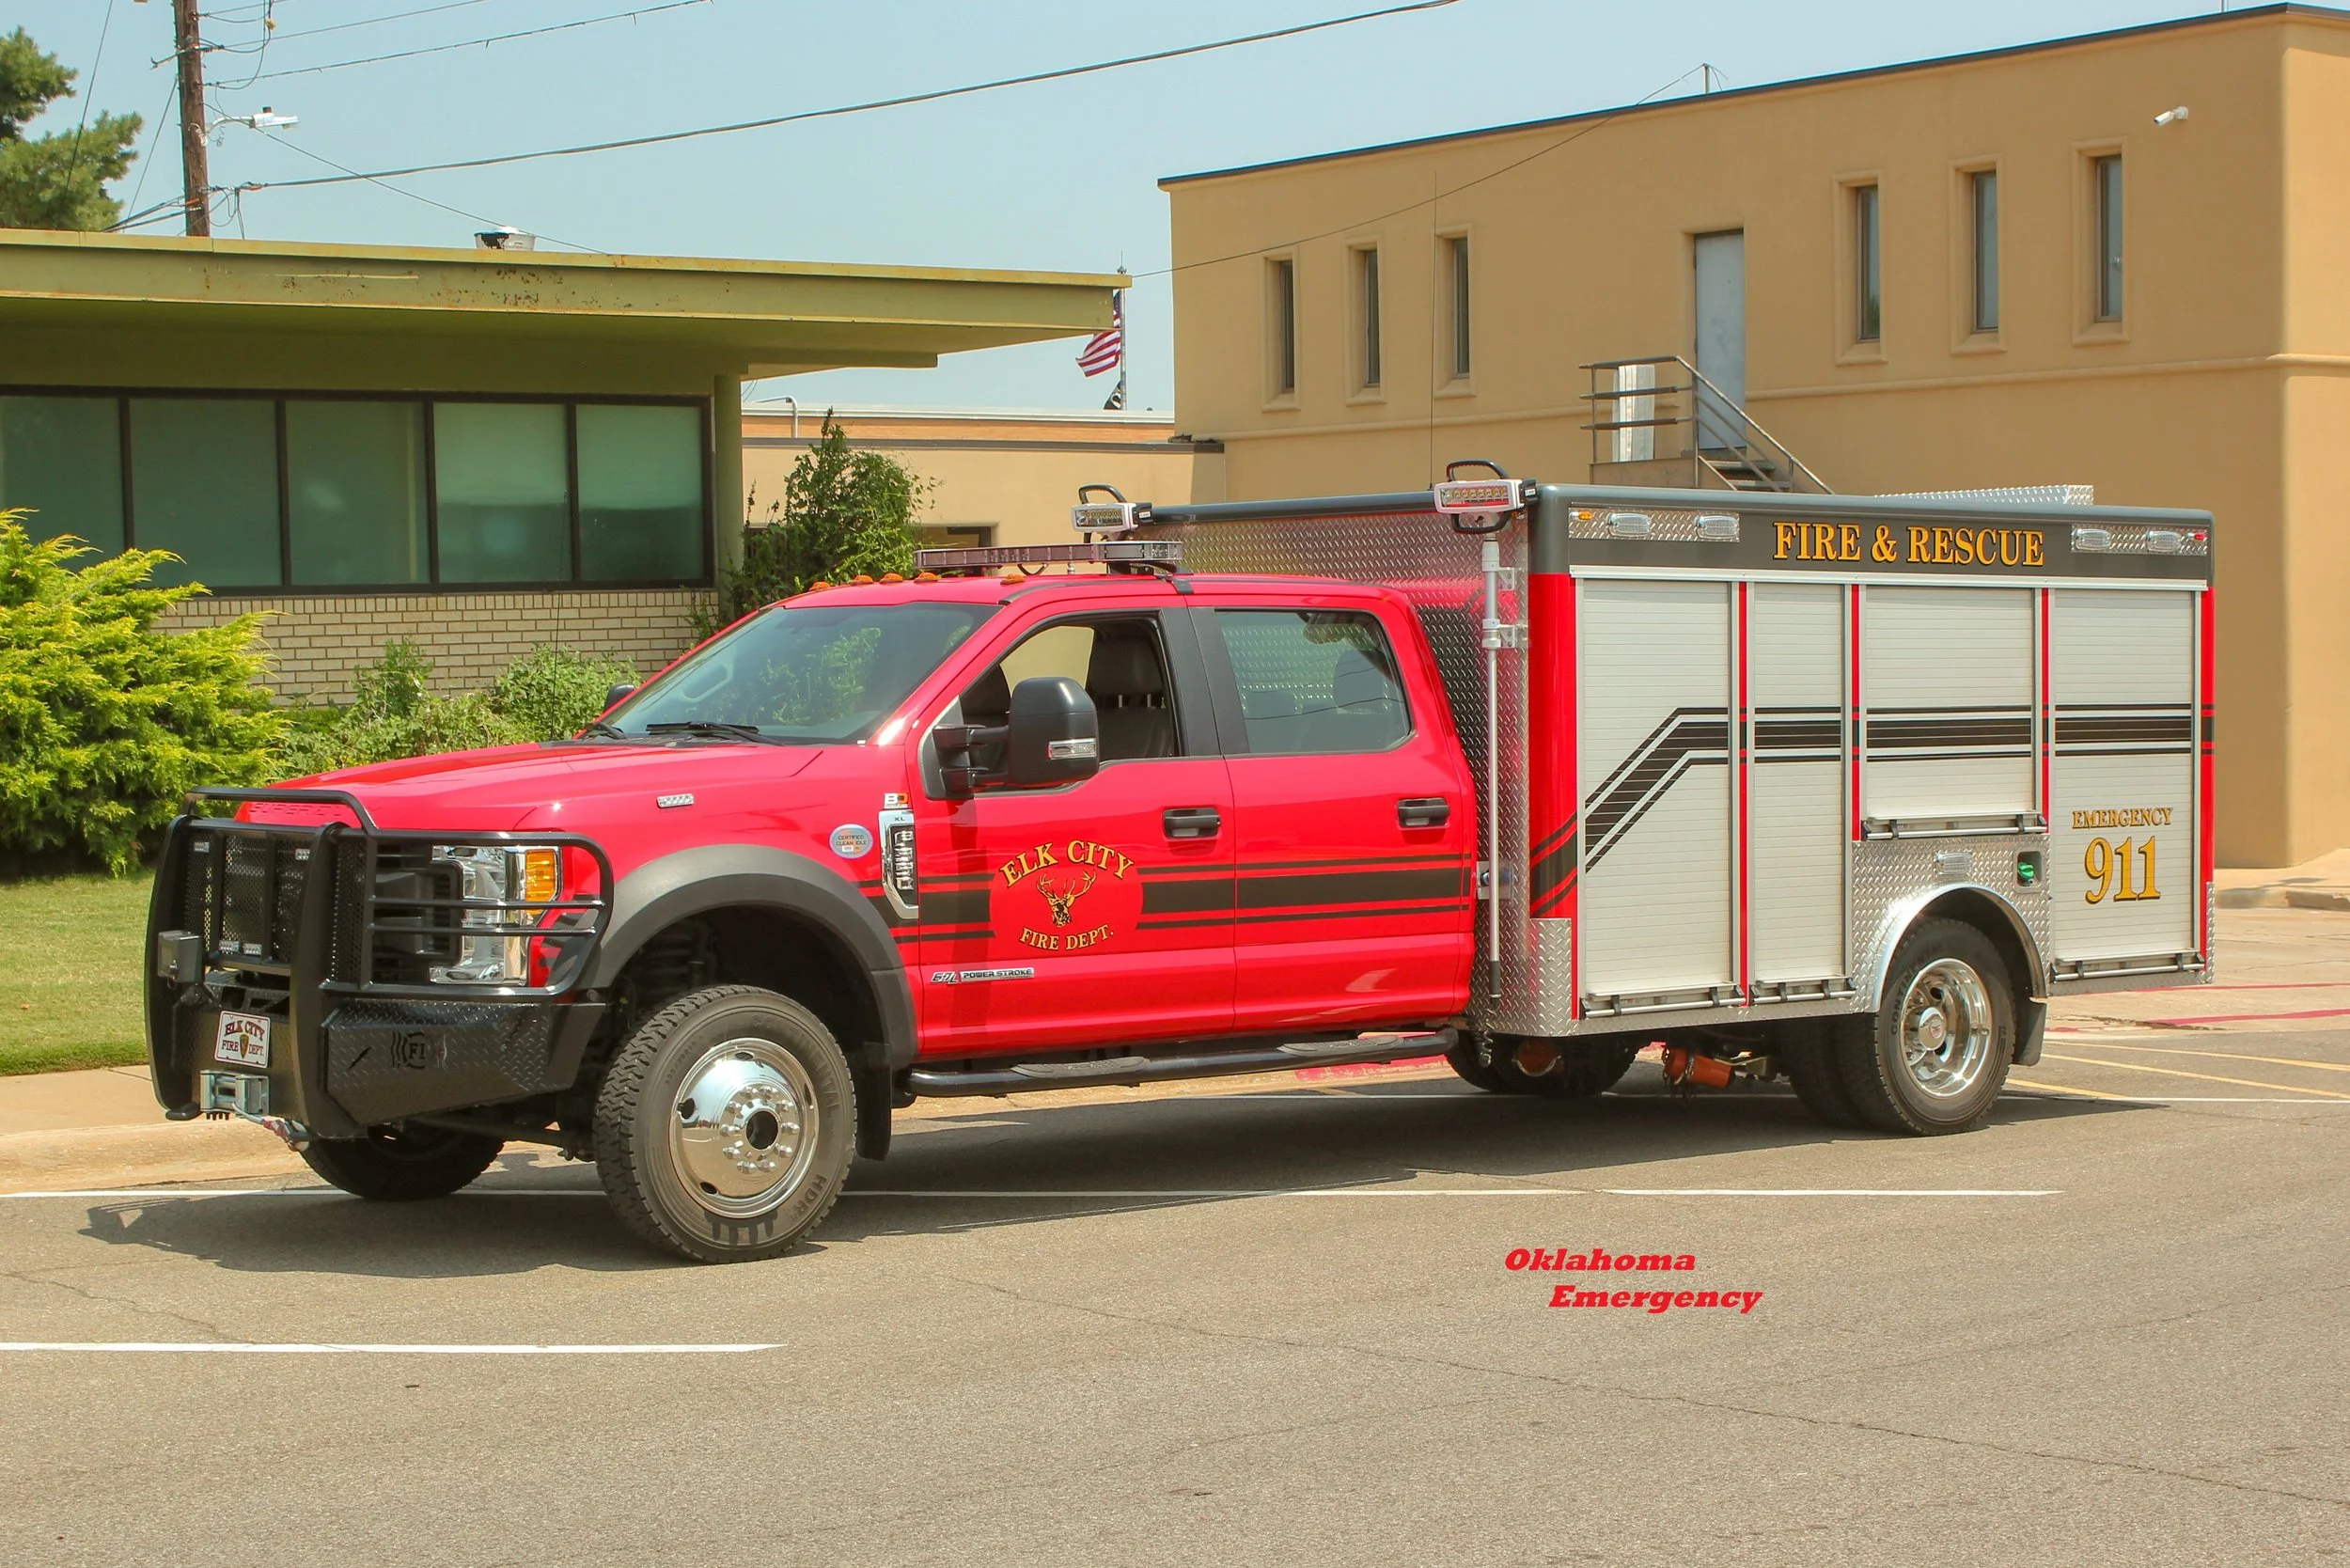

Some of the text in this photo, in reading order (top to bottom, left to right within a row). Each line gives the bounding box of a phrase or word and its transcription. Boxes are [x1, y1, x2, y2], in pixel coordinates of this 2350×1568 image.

[1773, 522, 2044, 566] FIRE & RESCUE
[2072, 808, 2173, 829] EMERGENCY
[999, 839, 1135, 888] ELK CITY
[2084, 836, 2161, 904] 911
[1019, 924, 1114, 950] FIRE DEPT.
[996, 968, 1033, 977] STROKE
[225, 1020, 265, 1041] ELK CITY
[222, 1040, 239, 1052] FIRE
